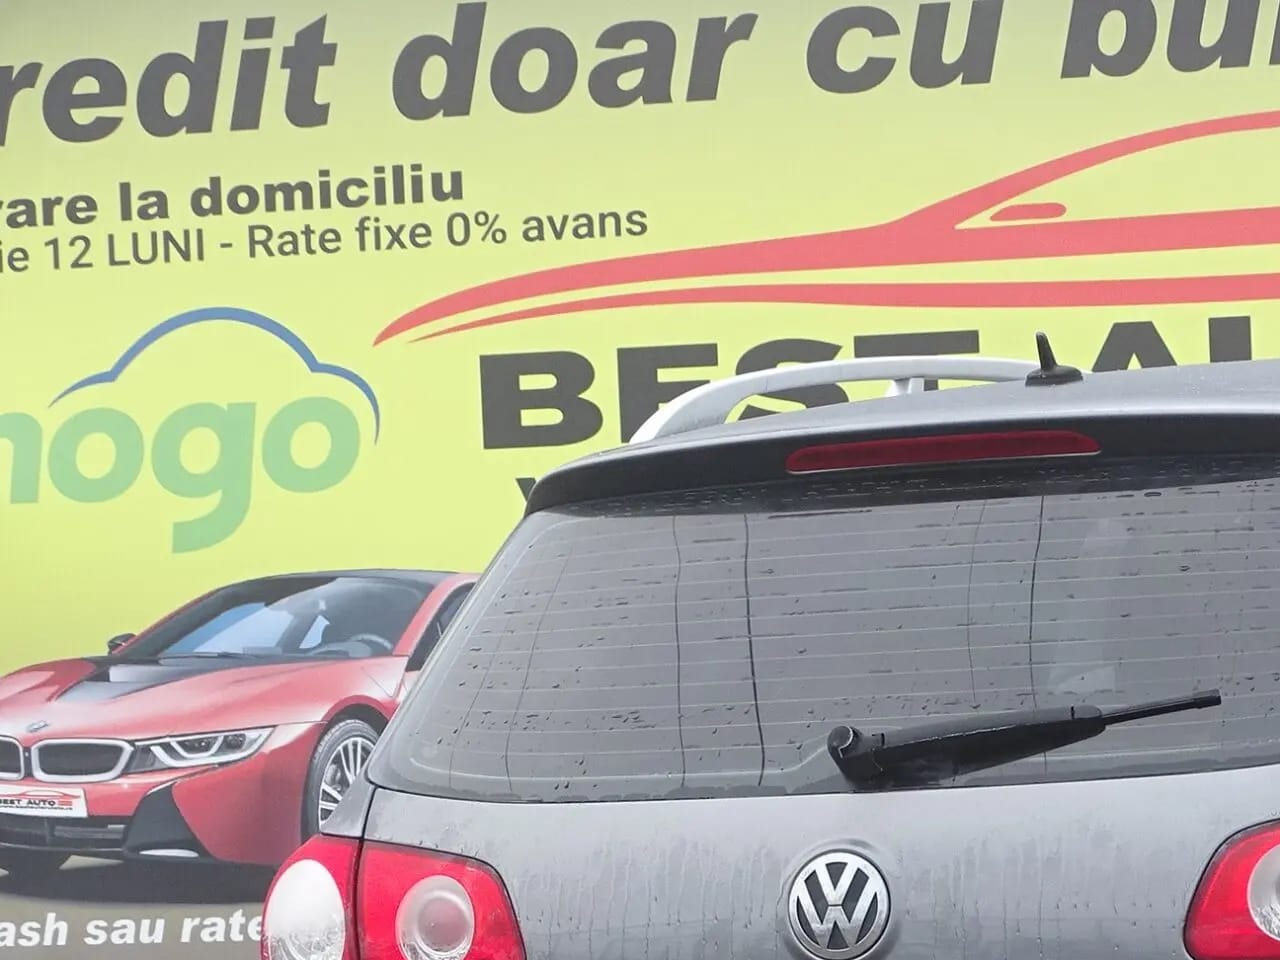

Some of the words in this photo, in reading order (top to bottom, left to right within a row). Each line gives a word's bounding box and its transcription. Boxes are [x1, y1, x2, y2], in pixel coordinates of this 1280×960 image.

[392, 1, 758, 120] doar
[806, 2, 1003, 94] cu
[0, 195, 98, 229] are
[119, 181, 170, 222] la
[190, 163, 465, 218] domiciliu
[44, 234, 94, 270] 12
[107, 227, 205, 267] LUNI
[219, 240, 234, 249] -
[248, 222, 342, 258] Rate
[356, 216, 433, 252] fixe
[446, 211, 507, 246] 0%
[521, 207, 649, 242] avans
[83, 917, 165, 946] sau
[180, 909, 264, 943] rate
